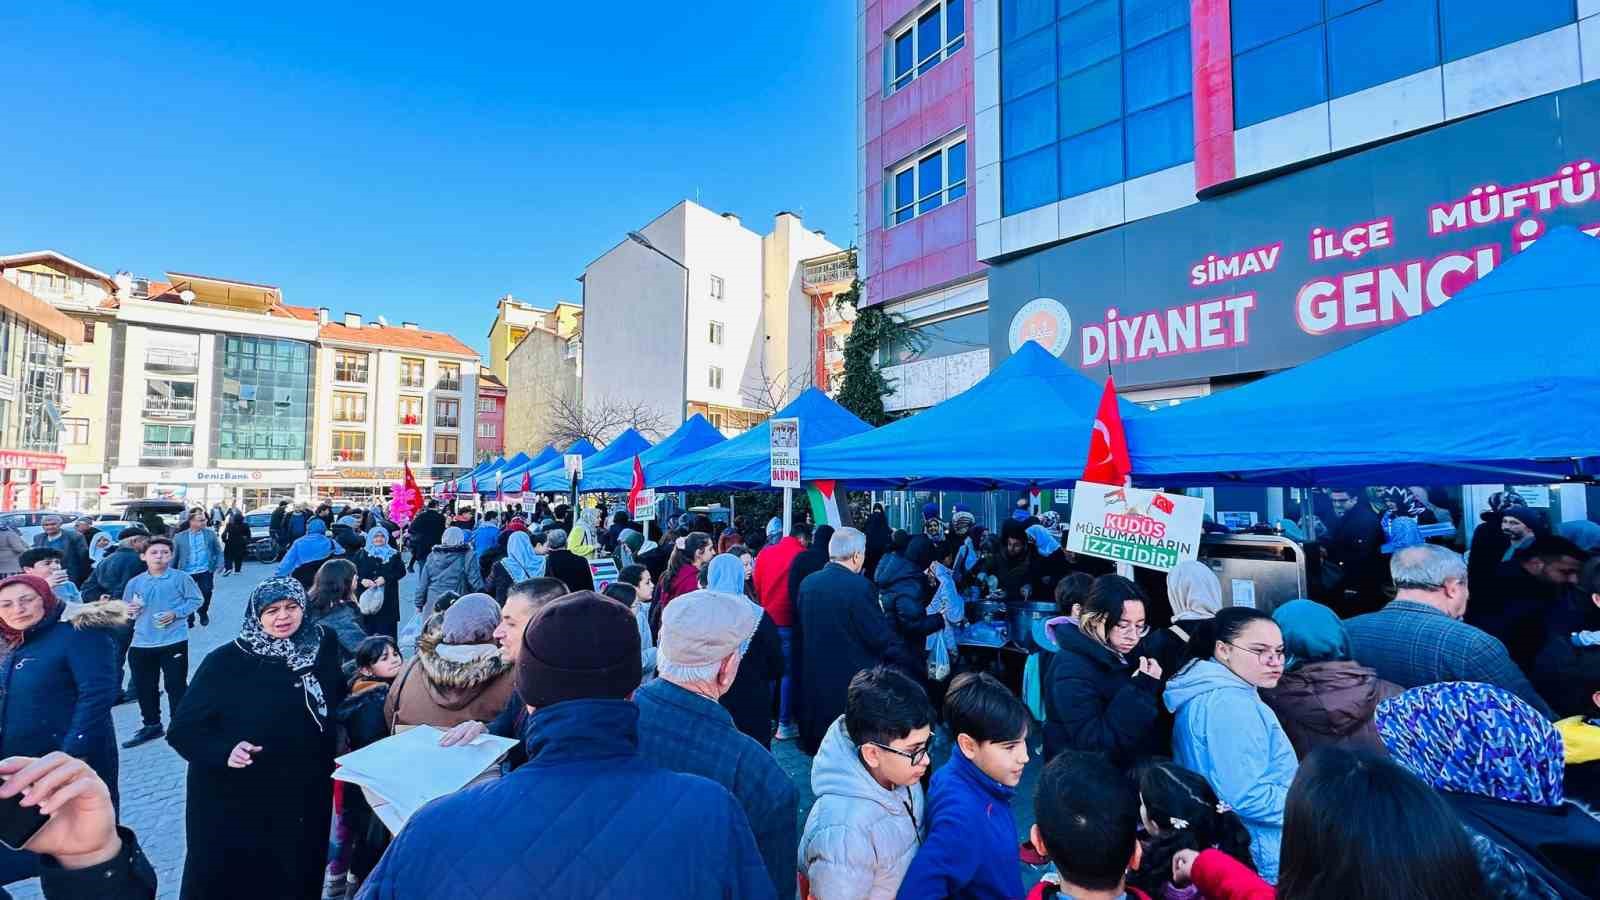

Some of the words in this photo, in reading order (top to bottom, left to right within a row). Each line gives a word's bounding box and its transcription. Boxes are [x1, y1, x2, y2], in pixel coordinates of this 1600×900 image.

[1191, 245, 1281, 286] SİMAV
[1312, 220, 1392, 262] İLÇE
[1430, 161, 1600, 234] MÜFTÜ
[1081, 294, 1254, 367] DİYANET
[197, 472, 249, 480] DenizBank
[1105, 514, 1165, 538] KUDÜS
